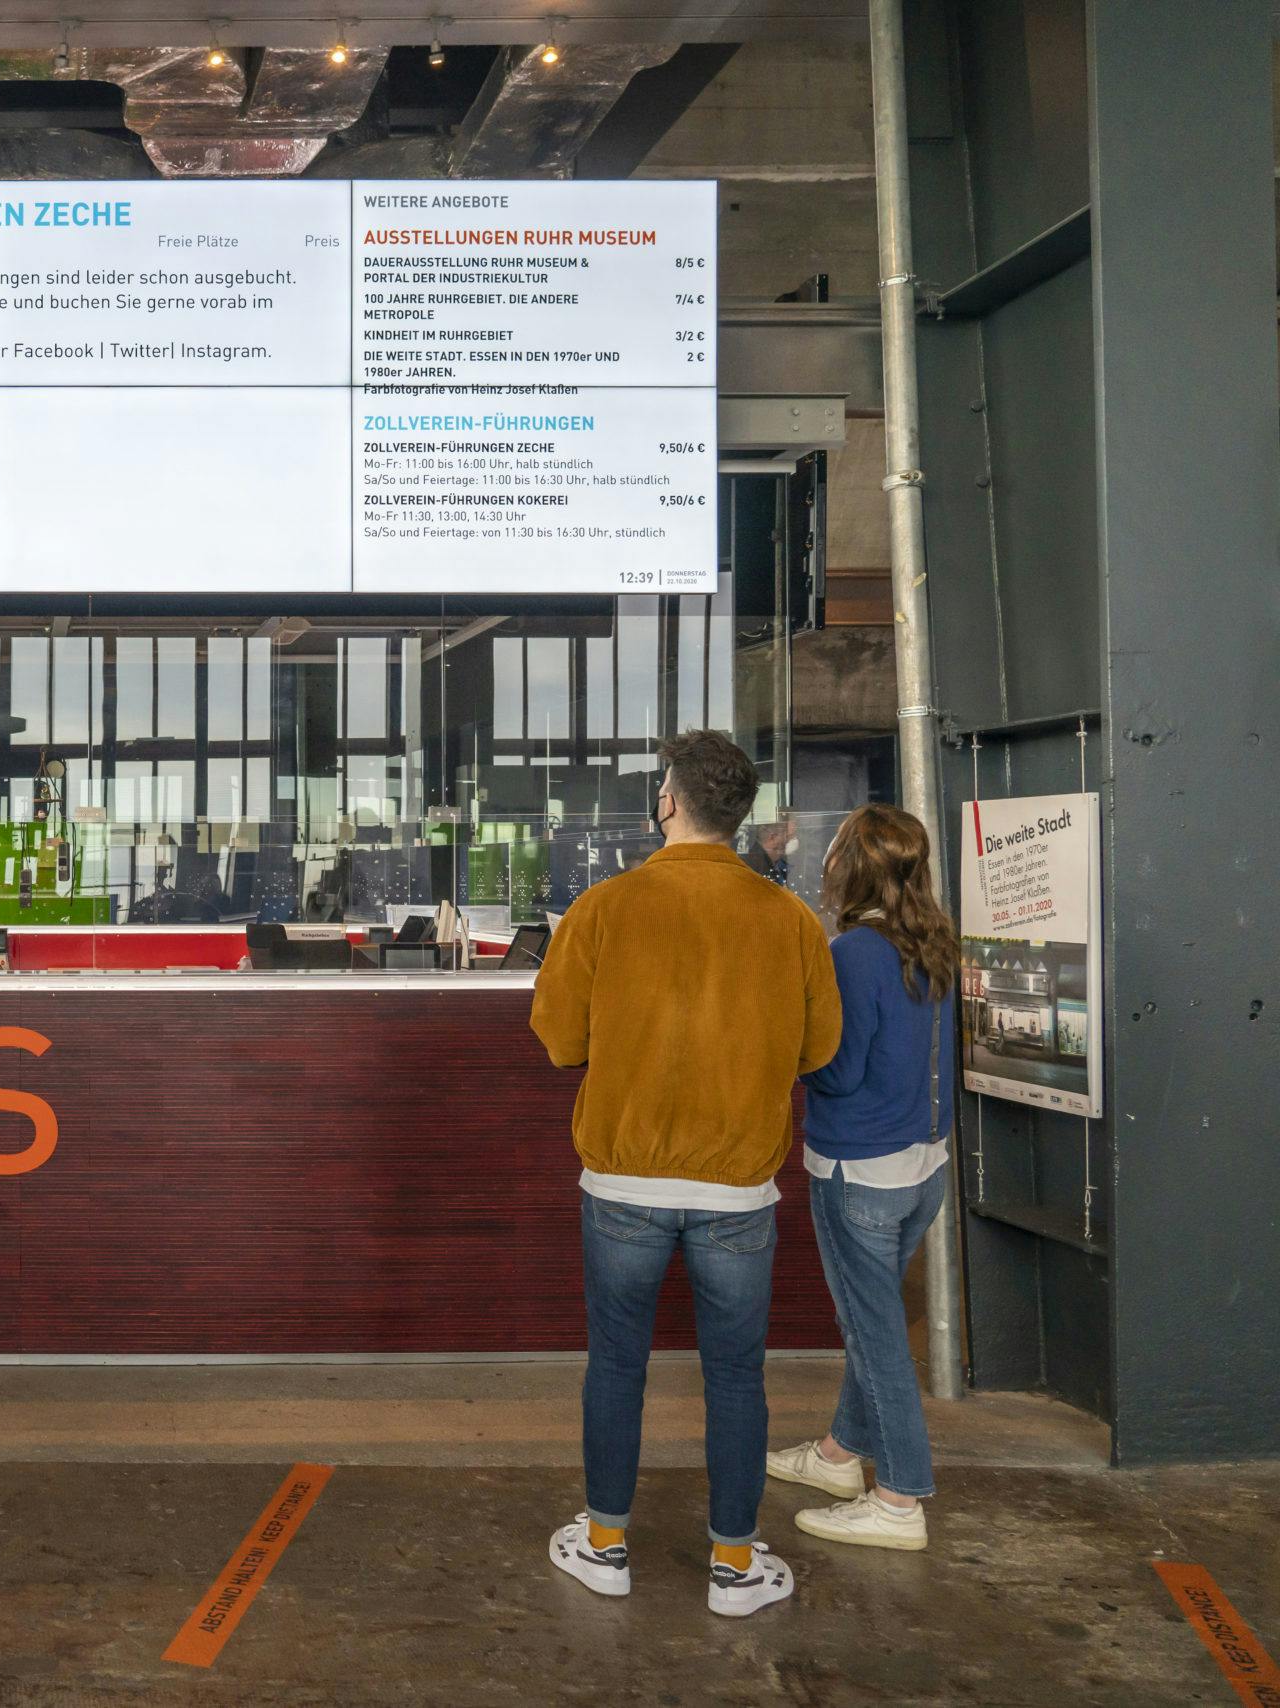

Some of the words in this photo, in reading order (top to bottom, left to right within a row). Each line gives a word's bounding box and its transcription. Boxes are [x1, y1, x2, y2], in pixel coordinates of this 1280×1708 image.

[363, 195, 428, 209] WEITERE
[431, 195, 509, 209] ANGEBOTE
[33, 201, 132, 227] ZECHE
[158, 234, 193, 248] Freie
[197, 234, 239, 248] Plätze
[304, 234, 340, 248] Preis
[363, 229, 518, 246] AUSSTELLUNGEN
[523, 230, 573, 246] RUHR
[578, 230, 657, 246] MUSEUM
[363, 256, 488, 268] DAUERAUSSTELLUNG
[491, 257, 524, 268] RUHR
[526, 257, 578, 268] MUSEUM
[580, 257, 590, 268] &
[675, 256, 694, 269] 8/5
[45, 269, 80, 285] sind
[86, 269, 135, 285] leider
[139, 269, 189, 285] schon
[194, 268, 297, 289] ausgebucht.
[364, 272, 410, 283] PORTAL
[412, 272, 436, 284] DER
[439, 272, 549, 284] INDUSTRIEKULTUR
[13, 293, 44, 310] und
[50, 293, 111, 310] buchen
[115, 293, 142, 310] Sie
[146, 297, 196, 314] gerne
[200, 293, 247, 309] vorab
[252, 293, 273, 309] im
[364, 293, 384, 304] 100
[386, 293, 425, 304] JAHRE
[427, 293, 506, 305] RUHRGEBIET.
[508, 293, 529, 305] DIE
[530, 293, 579, 305] ANDERE
[675, 293, 694, 306] 7/4
[363, 309, 435, 321] METROPOLE
[363, 329, 420, 341] KINDHEIT
[422, 330, 436, 341] IM
[439, 330, 514, 341] RUHRGEBIET
[675, 330, 694, 343] 3/2
[14, 342, 94, 359] Facebook
[181, 342, 272, 363] Instagram.
[363, 350, 383, 362] DIE
[385, 350, 423, 362] WEITE
[425, 350, 467, 362] STADT.
[469, 350, 508, 362] ESSEN
[510, 351, 523, 362] IN
[526, 351, 550, 362] DEN
[553, 351, 593, 362] 1970er
[594, 351, 620, 362] UND
[687, 351, 694, 362] 2
[364, 366, 403, 378] 1980er
[405, 366, 456, 378] JAHREN.
[363, 412, 595, 432] ZOLLVEREIN-FÜHRUNGEN
[363, 440, 514, 453] ZOLLVEREIN-FÜHRUNGEN
[516, 442, 555, 454] ZECHE
[659, 442, 695, 455] 9,50/6
[364, 473, 396, 486] Sa/So
[399, 474, 420, 485] und
[422, 474, 479, 488] Feiertage:
[482, 474, 512, 485] 11:00
[514, 474, 531, 486] bis
[534, 474, 564, 485] 16:30
[565, 474, 590, 487] Uhr,
[592, 474, 617, 486] halb
[619, 474, 671, 486] stündlich
[363, 492, 514, 506] ZOLLVEREIN-FÜHRUNGEN
[517, 494, 569, 506] KOKEREI
[659, 494, 695, 507] 9,50/6
[364, 510, 399, 522] Mo-Fr
[402, 510, 434, 523] 11:30,
[438, 510, 470, 523] 13:00,
[474, 510, 503, 522] 14:30
[505, 510, 527, 522] Uhr
[618, 571, 654, 584] 12:39
[985, 834, 1003, 854] Die
[1005, 825, 1035, 846] weite
[1037, 808, 1072, 836] Stadt
[988, 858, 1005, 870] Essen
[1006, 855, 1011, 864] in
[1013, 851, 1024, 862] den
[1026, 843, 1048, 857] 1970er
[990, 870, 1001, 883] und
[1003, 865, 1024, 879] 1980er
[1025, 858, 1048, 872] Jahren.
[1037, 872, 1050, 881] von
[991, 897, 1009, 909] Heinz
[1010, 889, 1026, 904] Josef
[1018, 898, 1053, 916] 01.11.2020
[198, 1588, 243, 1634] ABSTAND
[234, 1546, 269, 1586] HALTEN!
[258, 1520, 285, 1543] KEEP
[276, 1481, 313, 1520] DISTANCE!
[1182, 1585, 1239, 1642] DISTANCE!
[1221, 1642, 1263, 1674] KEEP
